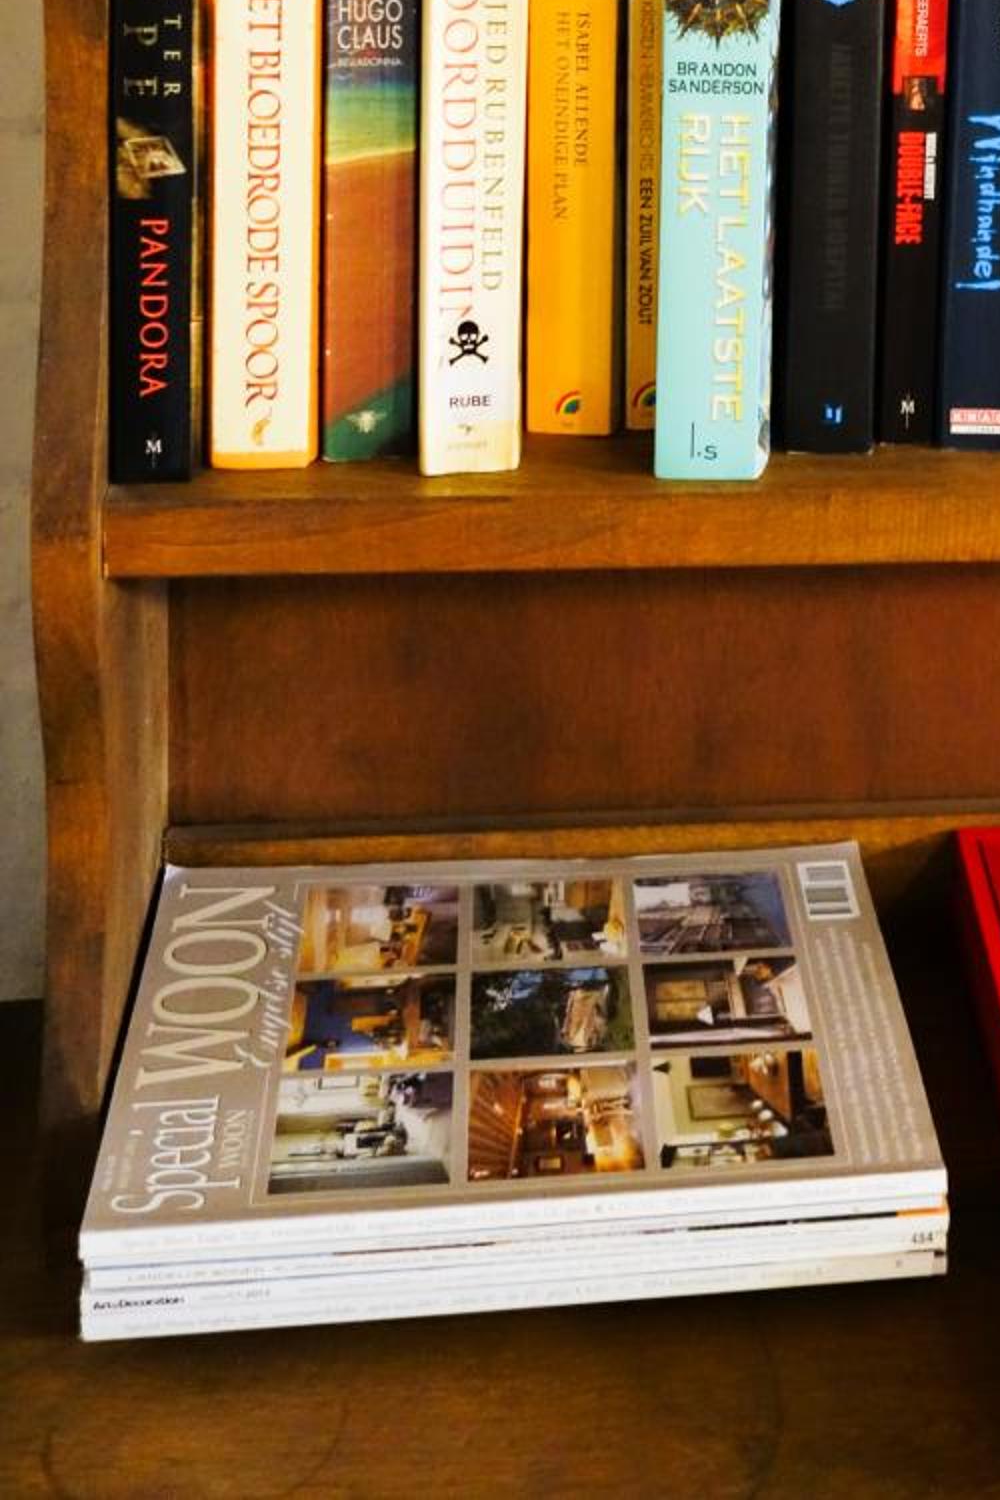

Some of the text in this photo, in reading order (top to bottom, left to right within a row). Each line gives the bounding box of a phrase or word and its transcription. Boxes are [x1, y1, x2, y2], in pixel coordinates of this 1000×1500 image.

[337, 25, 404, 50] CLAUS
[573, 11, 591, 167] ISABEL ALLENDE
[667, 78, 765, 95] SANDERSON
[676, 61, 758, 77] BRANDON
[246, 51, 282, 273] BLOEDRODE
[480, 2, 508, 291] JED RUBENFELD
[552, 11, 571, 220] HET ONEINDIGE PLAN
[675, 111, 711, 218] RIJK
[638, 214, 653, 248] ZUIL
[639, 177, 654, 209] EEN
[895, 132, 926, 245] DOUBLE-FACE
[137, 219, 169, 397] PANDORA
[637, 283, 653, 325] ZOUT
[638, 249, 653, 280] VAN
[709, 112, 753, 421] HET LAATSTE
[243, 280, 280, 409] SPOOR
[448, 395, 492, 409] RUBE
[133, 882, 276, 1092] WOON
[110, 1094, 241, 1213] Special
[217, 1108, 252, 1169] WOON
